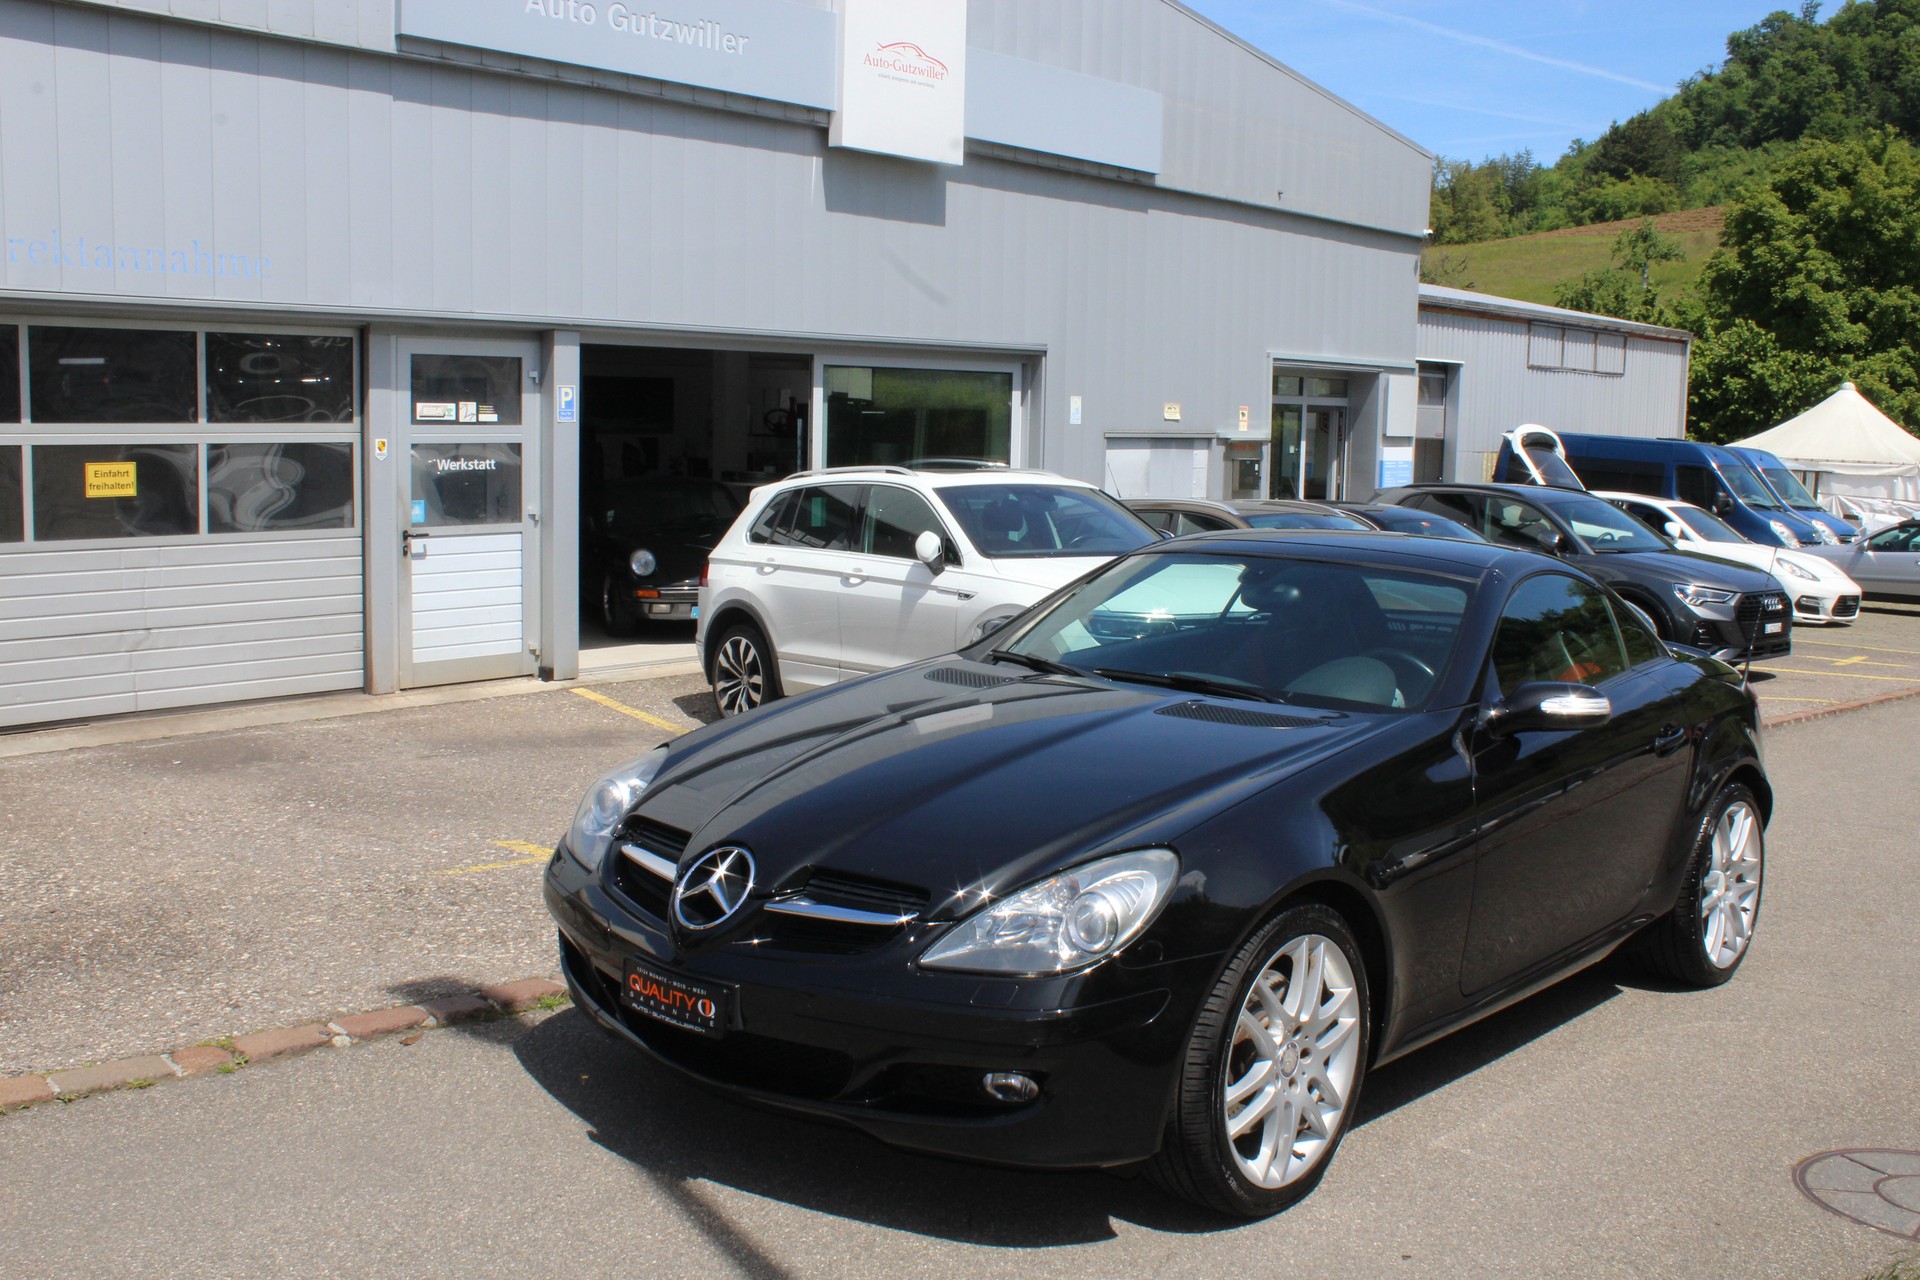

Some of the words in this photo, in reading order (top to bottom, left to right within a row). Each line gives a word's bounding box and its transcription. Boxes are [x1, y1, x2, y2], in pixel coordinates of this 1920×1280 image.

[524, 0, 597, 25] Auto
[606, 3, 749, 55] Gutzwiller
[863, 53, 945, 80] Auto-Gutzwiller
[561, 387, 573, 408] P
[94, 469, 130, 478] Einfahrt
[437, 458, 496, 471] Werkstatt
[89, 481, 135, 491] freihalten!
[629, 974, 696, 1011] QUALITY
[629, 991, 715, 1028] GARANTIE
